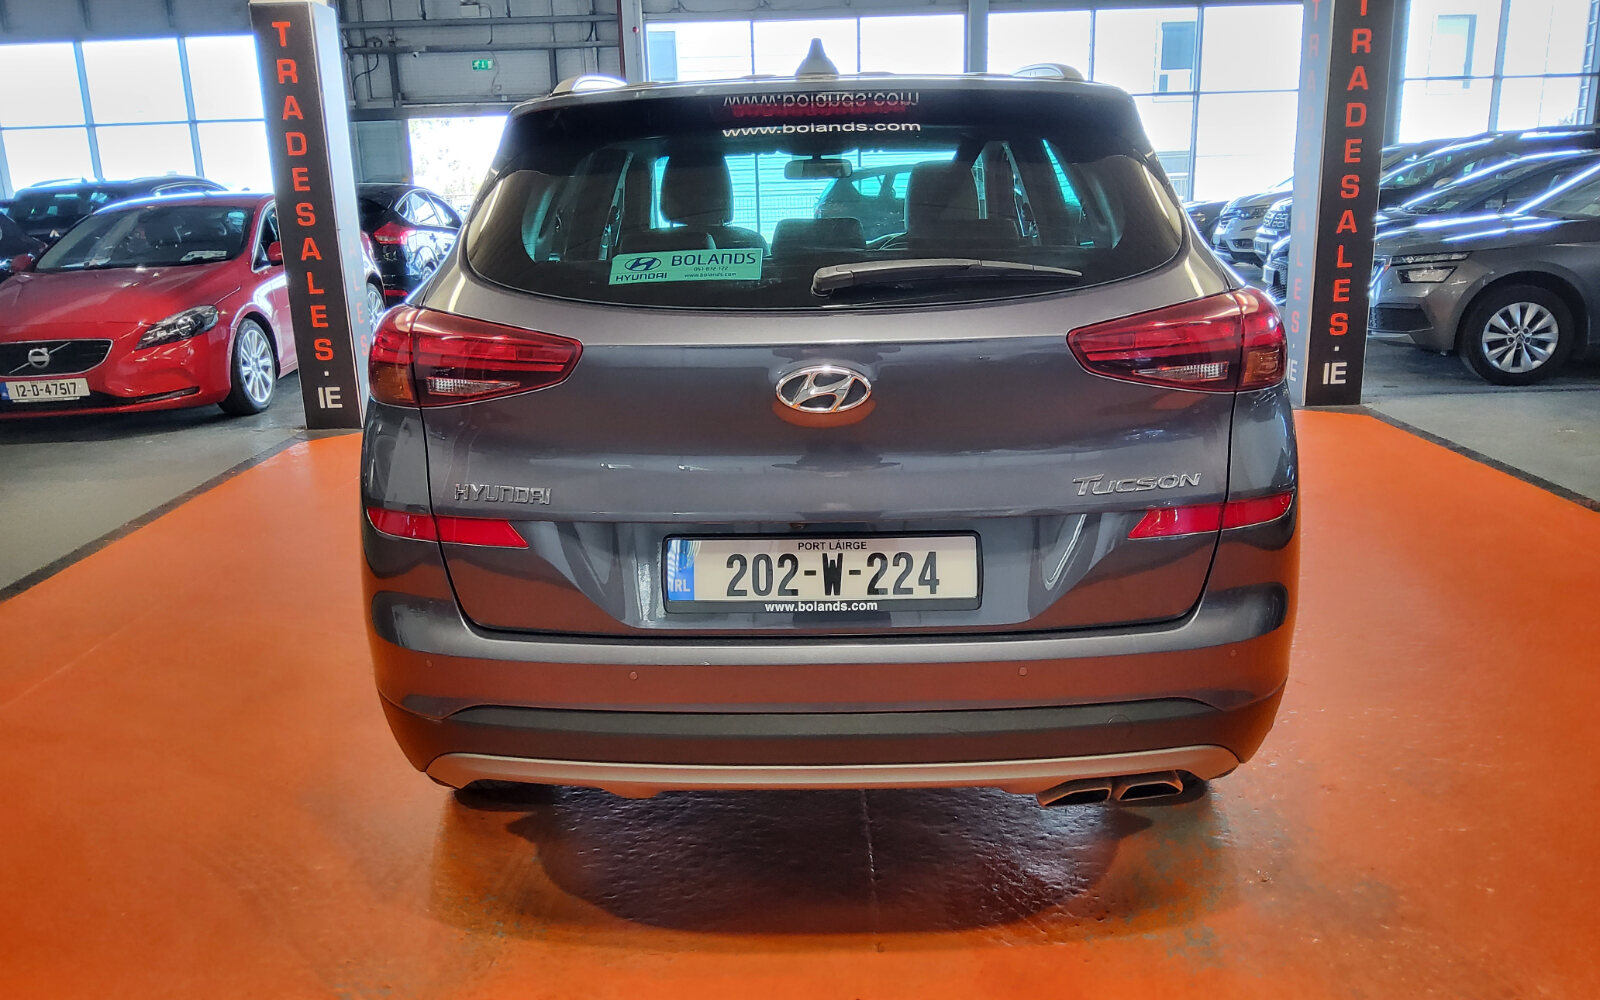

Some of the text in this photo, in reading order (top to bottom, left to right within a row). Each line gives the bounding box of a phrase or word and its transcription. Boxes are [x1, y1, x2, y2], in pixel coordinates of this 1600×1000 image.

[722, 122, 921, 137] www.bolands.com
[671, 252, 756, 266] BOLANDS
[615, 272, 668, 282] HYUNDAI
[15, 382, 77, 397] 12-D-47517
[1072, 472, 1202, 496] TUCSON
[454, 483, 552, 505] HYUNDAI
[797, 540, 867, 551] PORT LÁIRGE
[726, 551, 940, 597] 202-W-224
[764, 600, 878, 612] www.bolands.com
